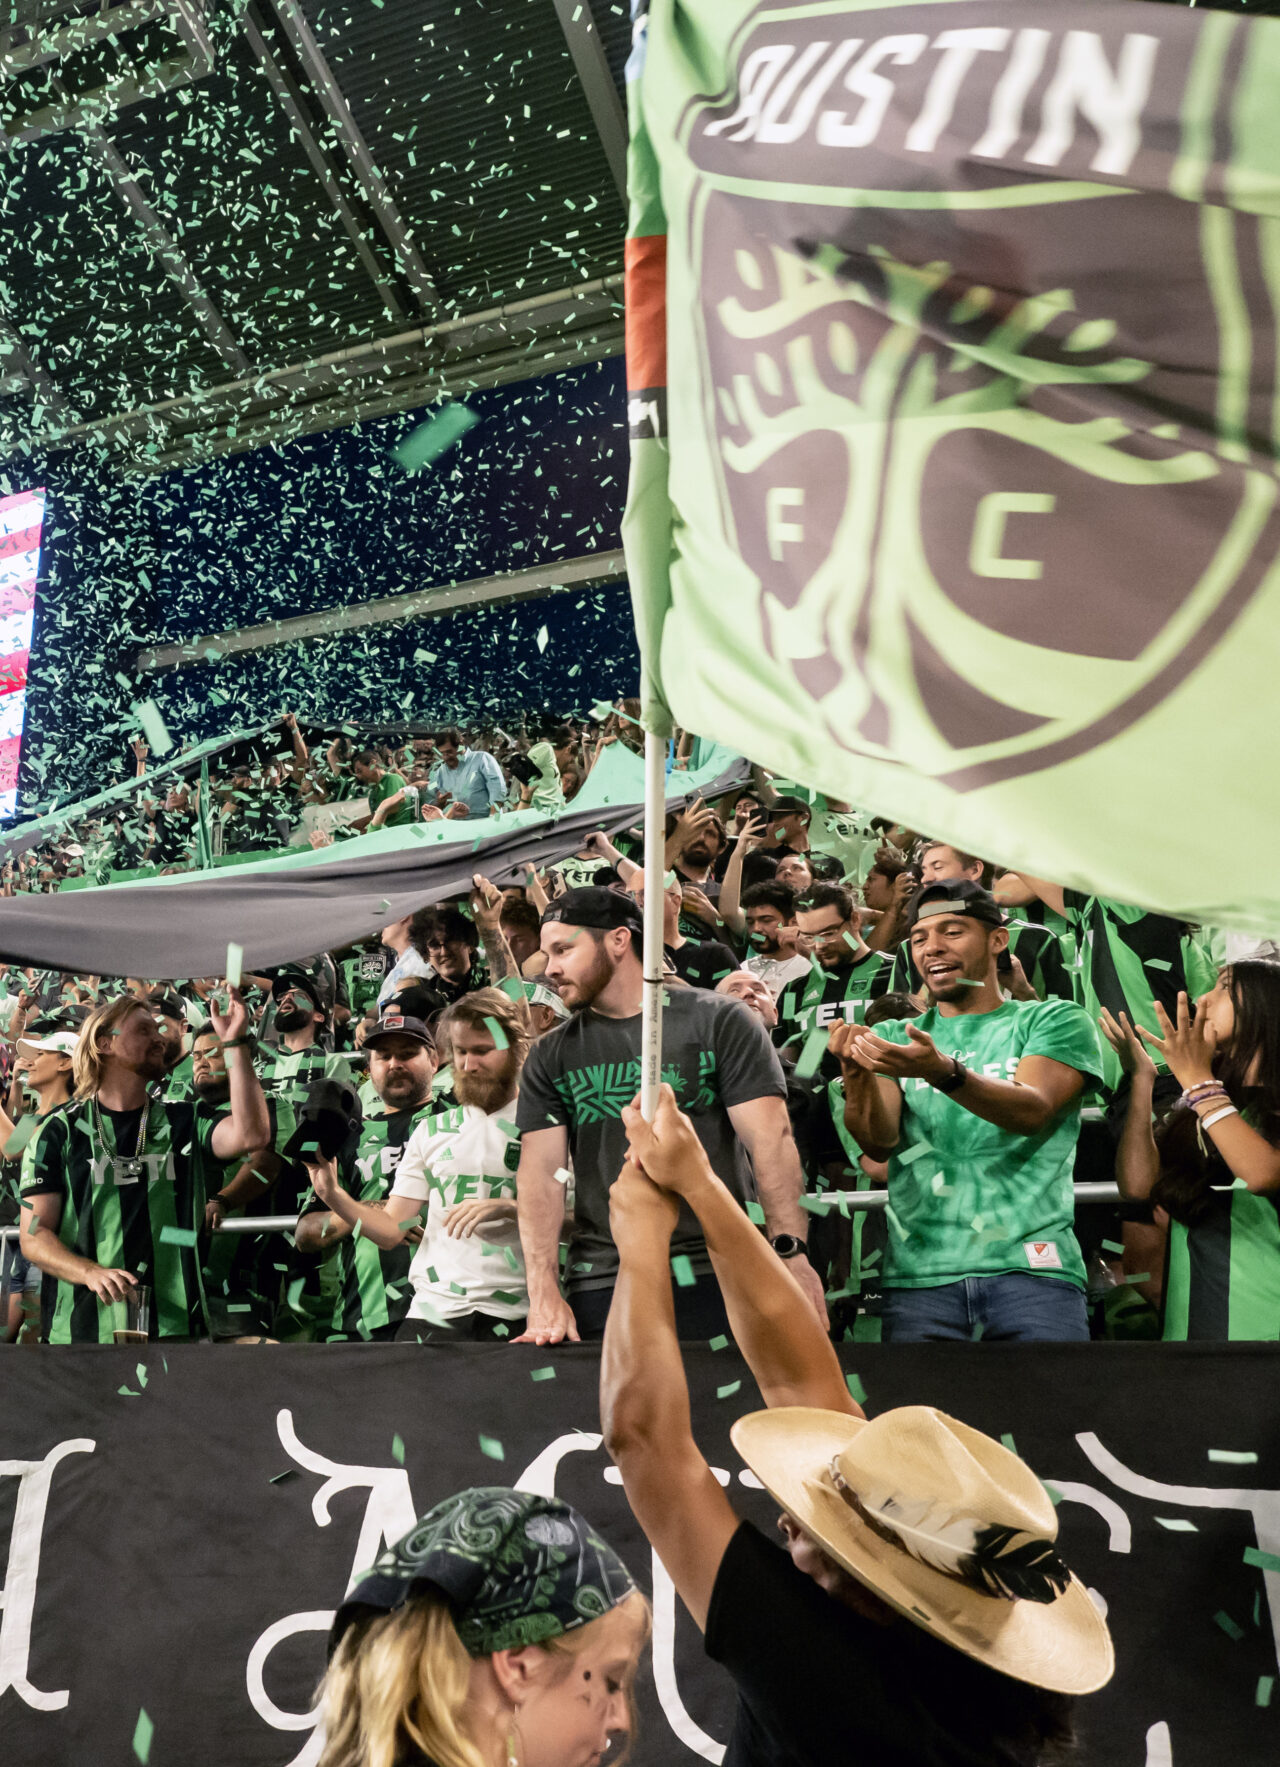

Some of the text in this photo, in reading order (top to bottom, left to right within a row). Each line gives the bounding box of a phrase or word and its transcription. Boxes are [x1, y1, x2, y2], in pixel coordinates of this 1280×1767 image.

[704, 27, 1159, 174] AUSTIN
[766, 487, 1057, 580] F C
[563, 868, 596, 882] YET
[86, 1152, 176, 1186] YETI
[422, 1167, 518, 1208] YET
